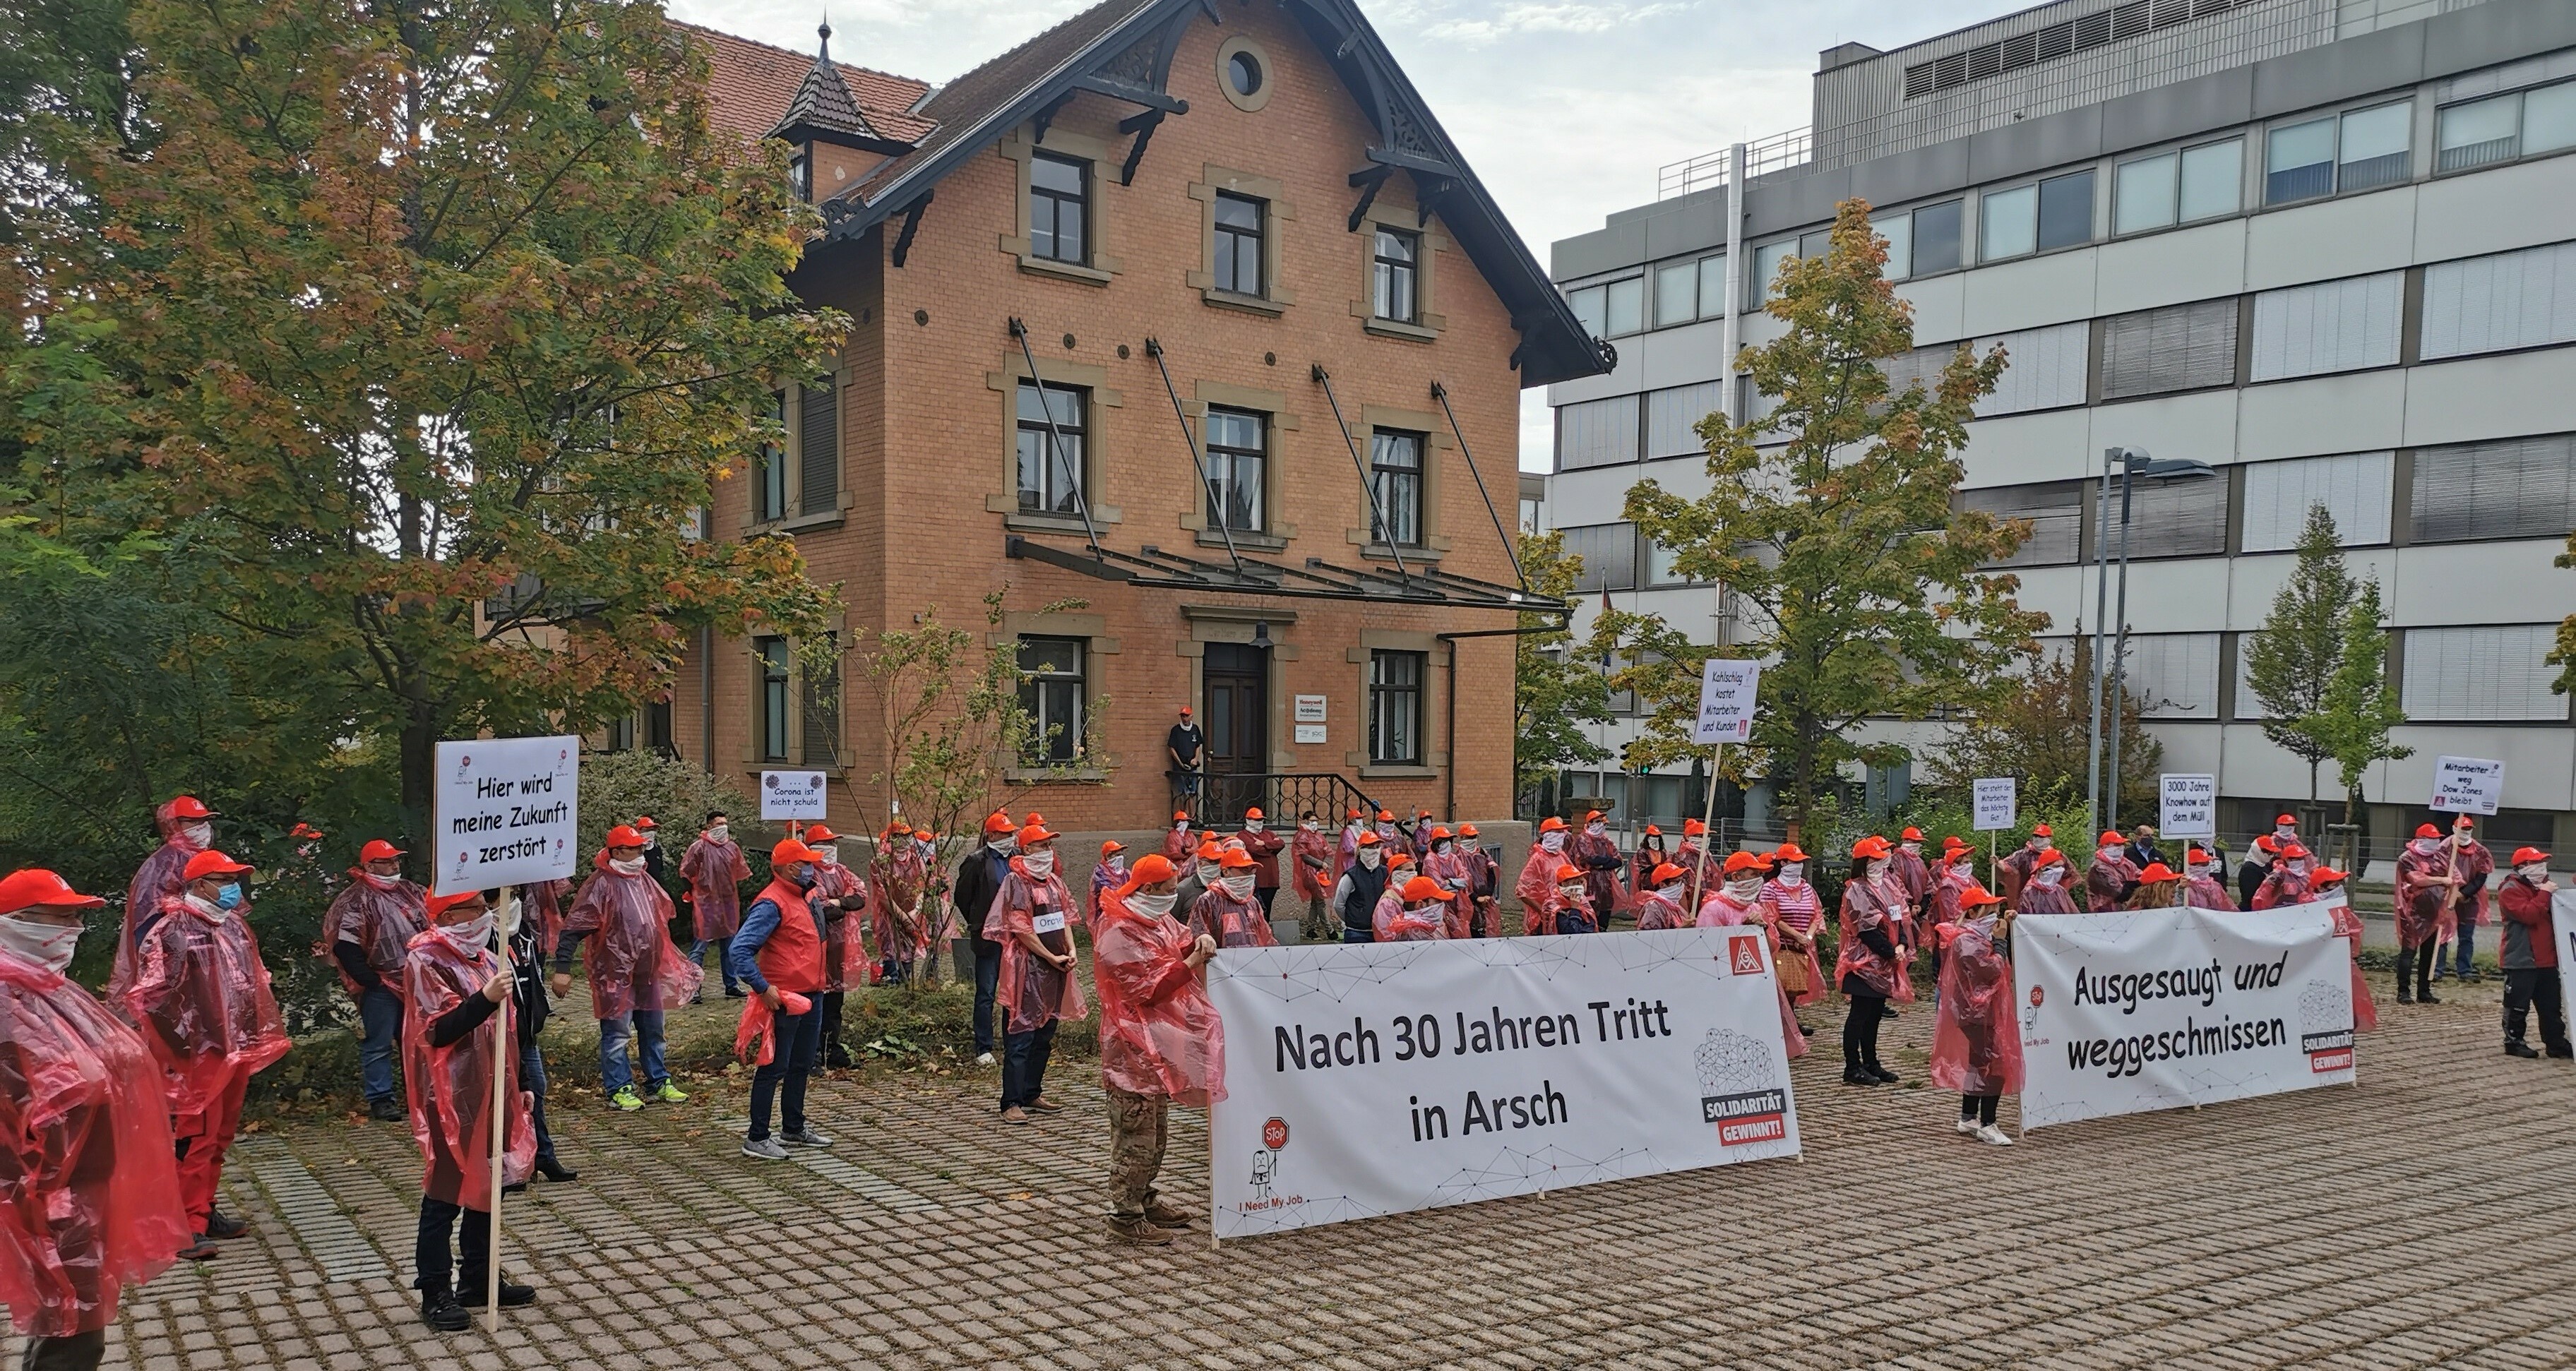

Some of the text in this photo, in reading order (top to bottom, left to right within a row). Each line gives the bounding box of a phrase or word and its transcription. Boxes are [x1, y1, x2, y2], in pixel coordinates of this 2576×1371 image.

[1712, 671, 1743, 686] Kahlschlag
[1715, 688, 1735, 699] kostet
[1705, 705, 1741, 715] Mitarbeiter
[1703, 721, 1715, 731] und
[1716, 721, 1736, 731] Kunden
[2444, 763, 2488, 774] Mitarbeiter
[477, 771, 552, 799] Hier wird
[2167, 780, 2209, 791] 3000 Jahre
[2457, 777, 2471, 785] weg
[2443, 784, 2482, 795] Dow Jones
[2165, 795, 2211, 806] Knowhow auf
[2450, 796, 2472, 805] bleibt
[453, 801, 568, 834] meine Zukunft
[2173, 811, 2205, 821] dem Müll
[479, 836, 547, 863] zerstört
[2074, 950, 2289, 1015] Ausgesaugt und
[1275, 999, 1673, 1073] Nach 30 Jahren Tritt
[2303, 1031, 2354, 1051] SOLIDARITÄT
[2068, 1014, 2286, 1079] weggeschmissen
[2313, 1053, 2351, 1070] GEWINNT!
[1410, 1080, 1568, 1143] in Arsch
[1706, 1092, 1782, 1119] SOLIDARITÄT
[1722, 1120, 1782, 1142] GEWINNT!
[1239, 1195, 1303, 1211] I Need My Job
